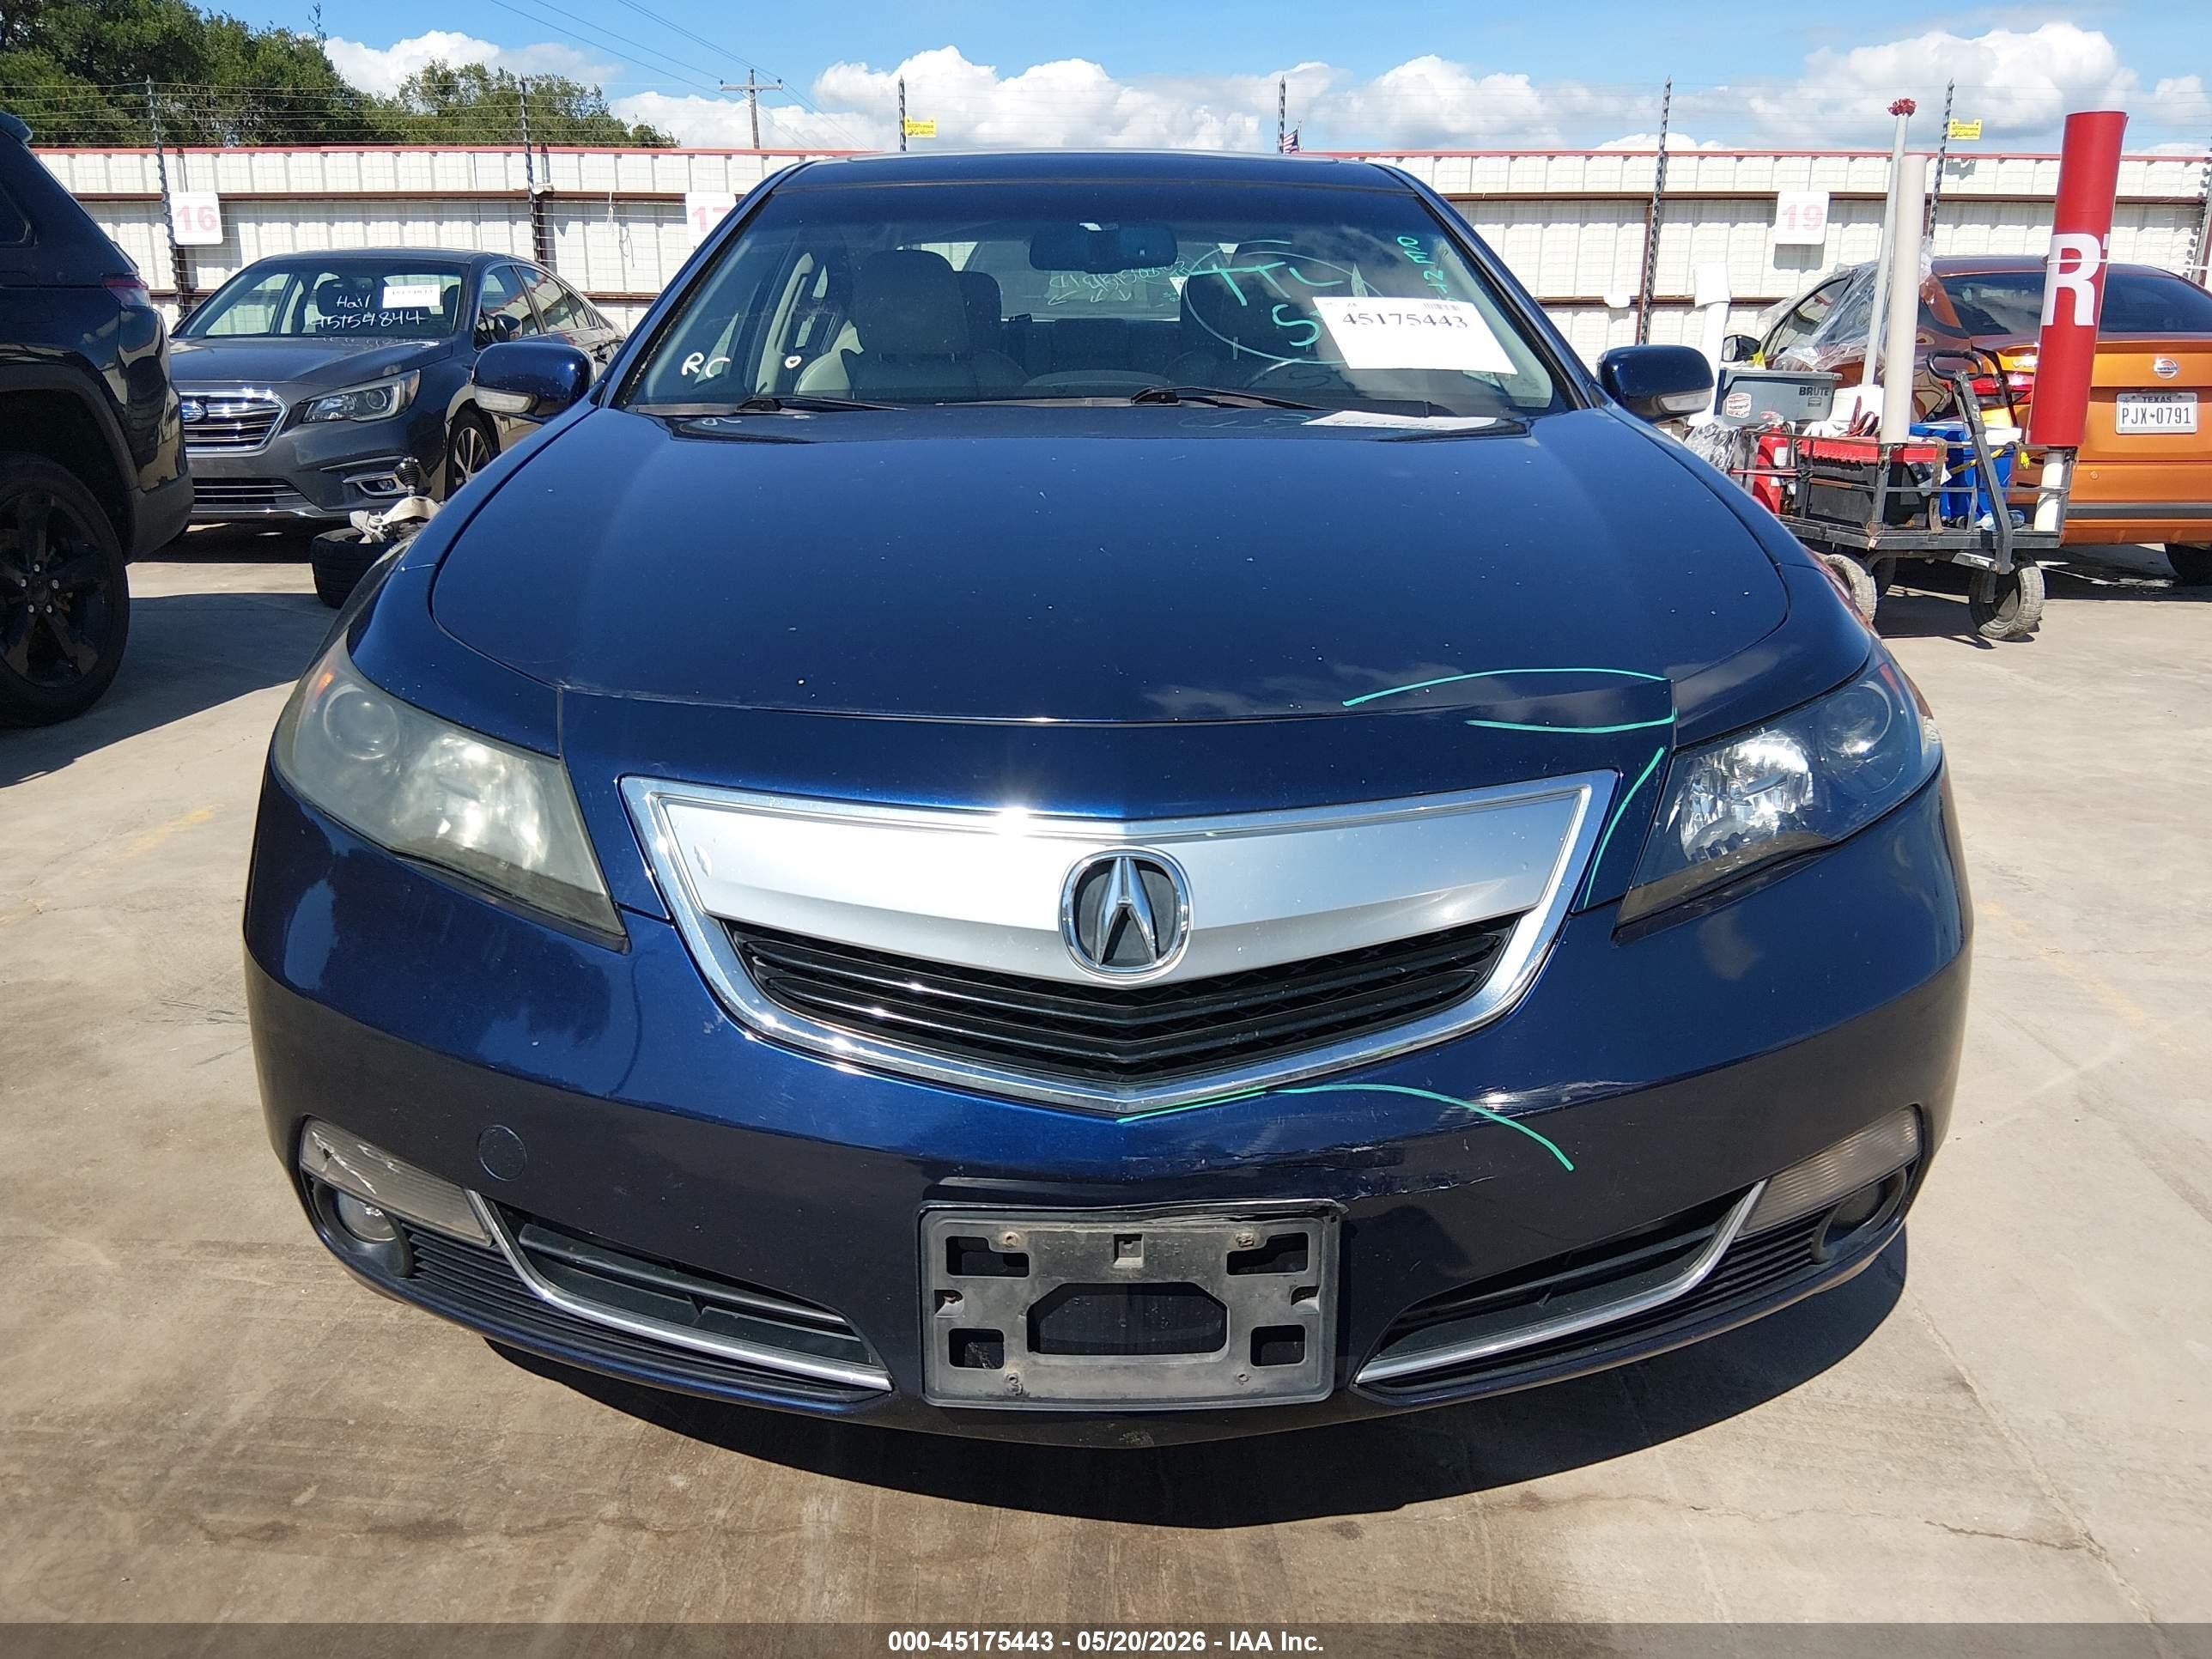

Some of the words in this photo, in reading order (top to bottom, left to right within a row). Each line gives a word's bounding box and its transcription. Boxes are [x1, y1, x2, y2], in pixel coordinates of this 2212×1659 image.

[177, 205, 217, 231] 16
[1782, 204, 1823, 230] 19
[2040, 233, 2109, 325] R
[336, 294, 371, 308] Hail
[1342, 313, 1469, 329] 45175443
[681, 351, 731, 378] RC
[1799, 386, 1830, 396] BRUTE
